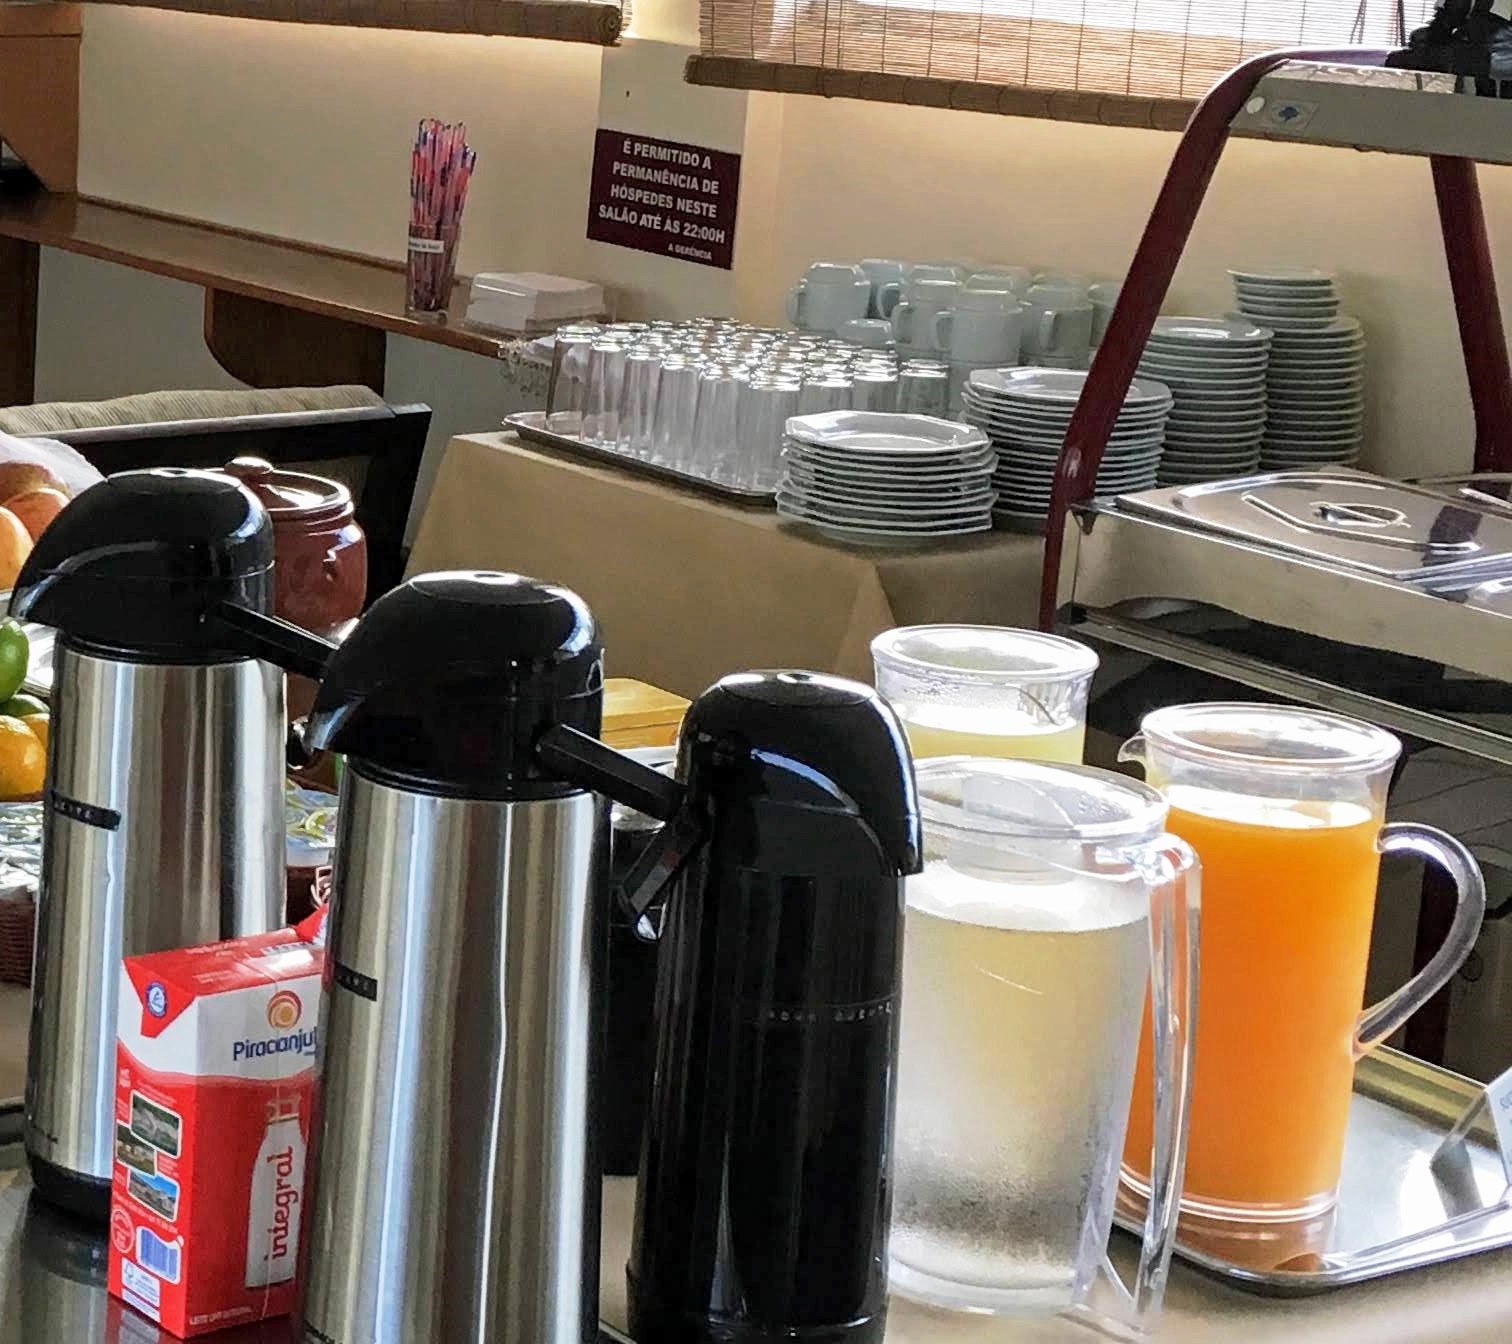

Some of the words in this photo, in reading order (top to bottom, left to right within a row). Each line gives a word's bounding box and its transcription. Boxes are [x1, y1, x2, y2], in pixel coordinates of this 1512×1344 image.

[623, 138, 632, 154] É
[634, 142, 699, 167] PERMITIDO
[702, 155, 711, 170] A
[612, 161, 699, 190] PERMANÊNCIA
[702, 178, 719, 195] DE
[611, 182, 673, 209] HÓSPEDES
[677, 197, 717, 219] NESTE
[598, 204, 637, 225] SALÃO
[639, 212, 662, 230] ATÉ
[683, 222, 725, 244] 22:00H
[668, 243, 674, 252] A
